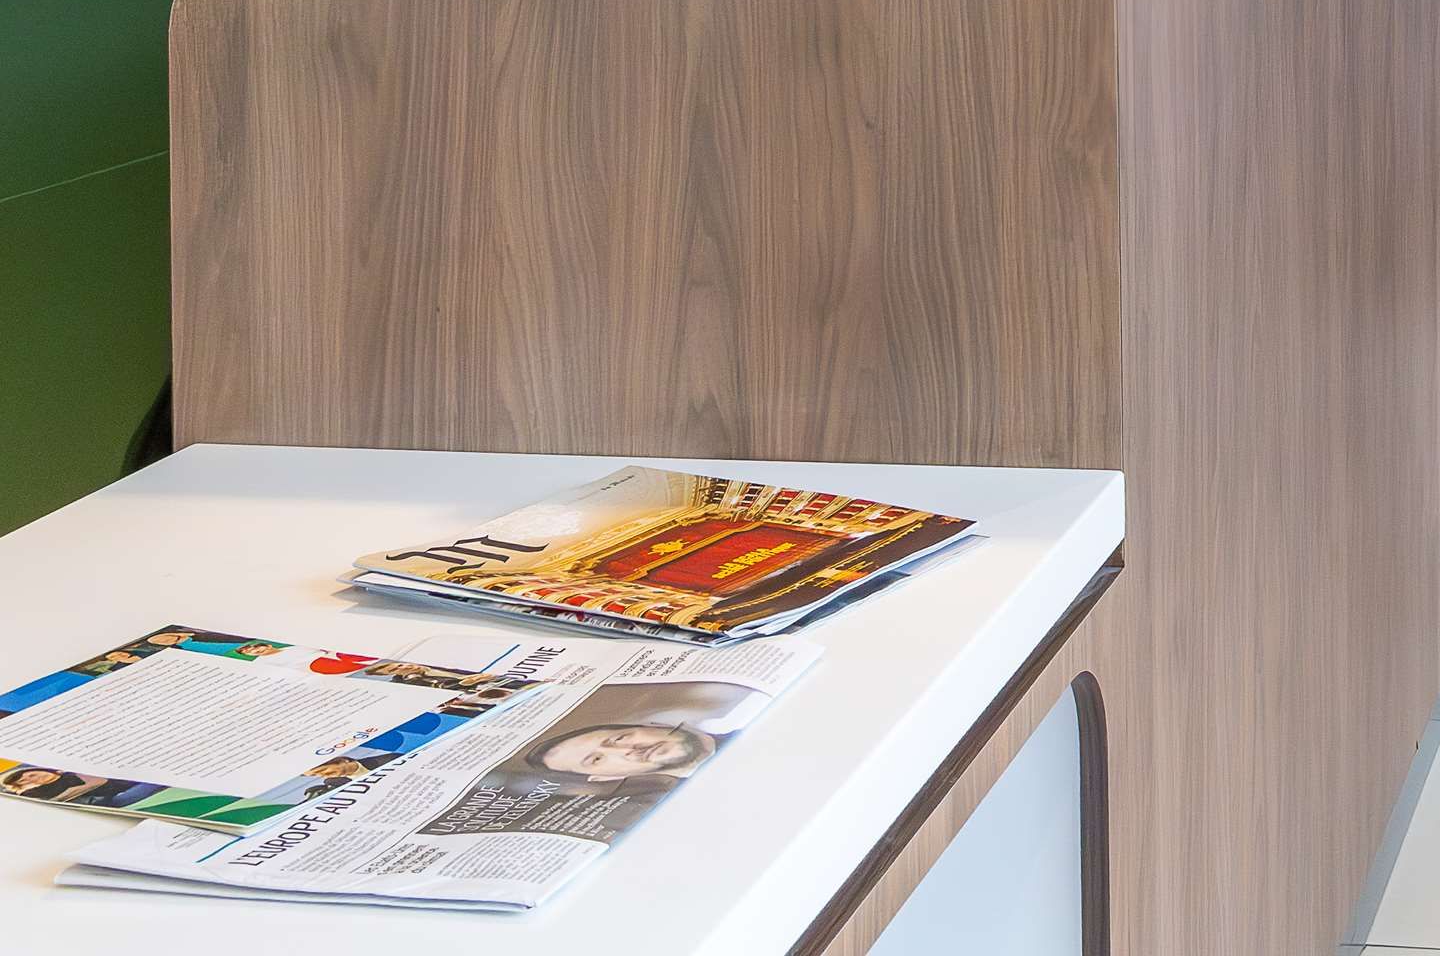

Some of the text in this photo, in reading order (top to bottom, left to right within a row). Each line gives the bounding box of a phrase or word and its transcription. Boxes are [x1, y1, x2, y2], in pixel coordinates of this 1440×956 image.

[315, 728, 379, 756] Google
[227, 814, 334, 867] L'EUROPE
[316, 791, 357, 816] AU
[430, 819, 461, 833] LA
[446, 784, 505, 821] GRANDE
[457, 794, 523, 832] SOLITUDE
[480, 818, 513, 832] DE
[497, 779, 561, 820] ZELENSKY
